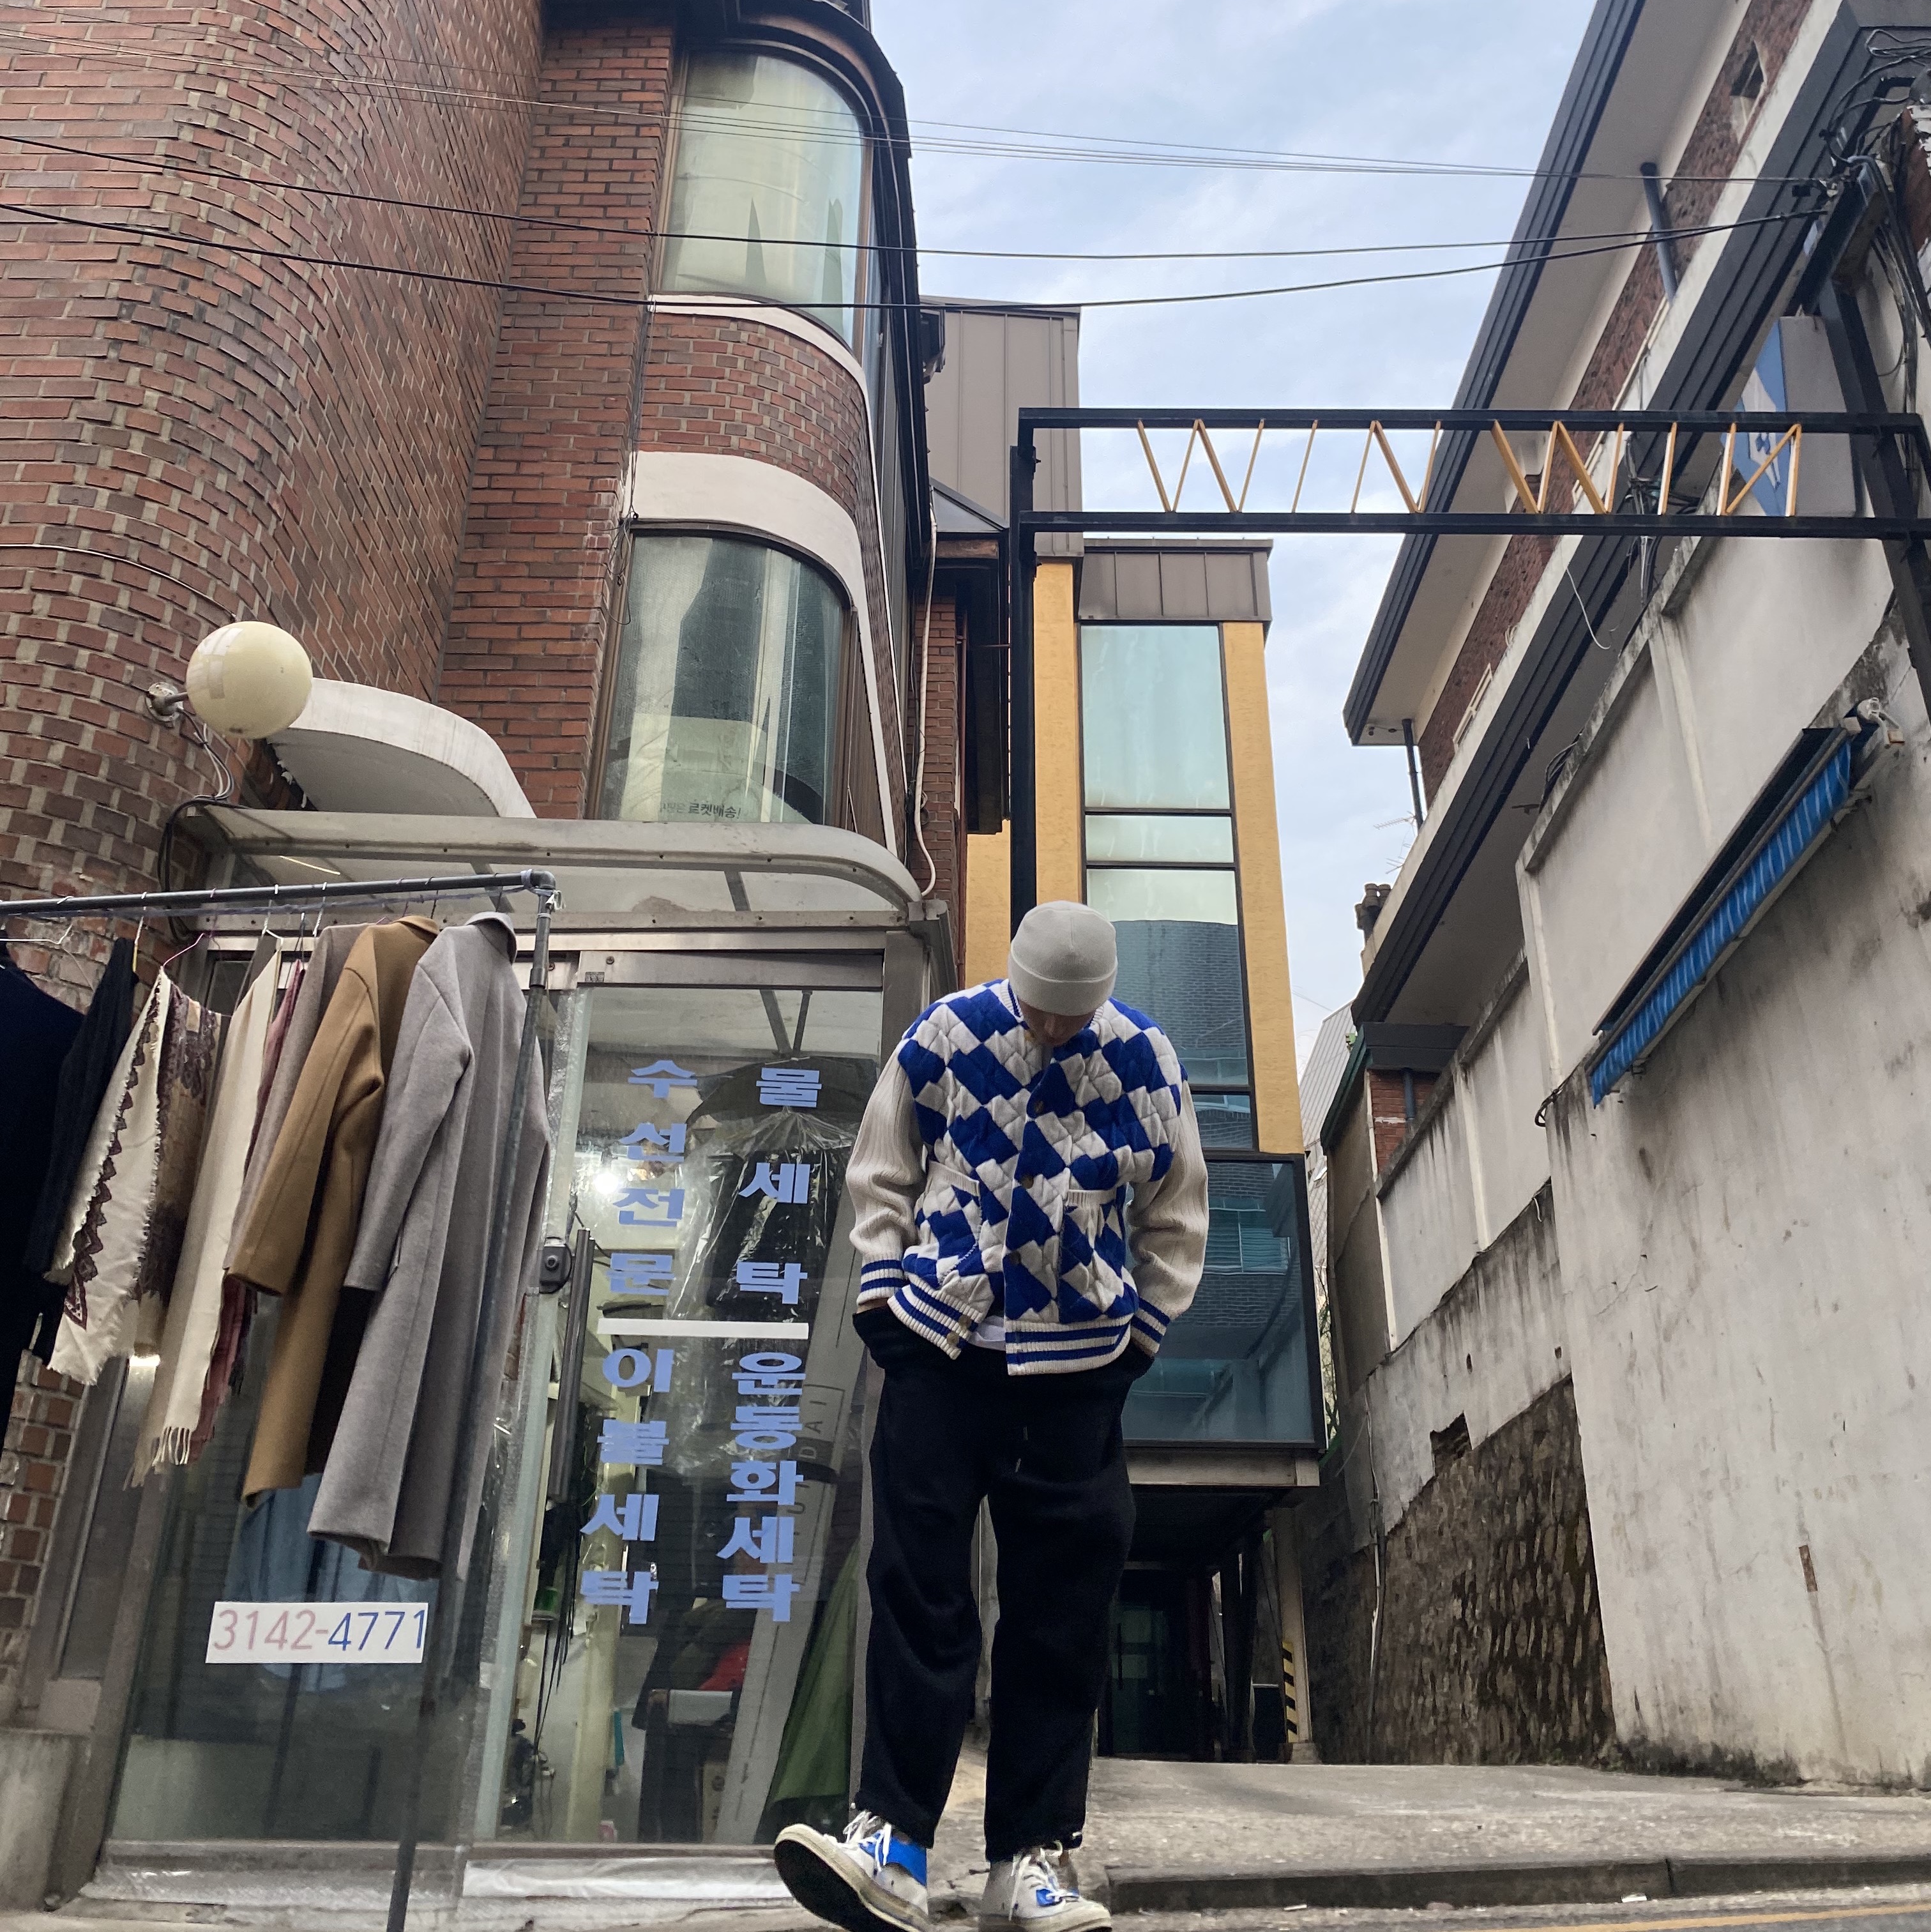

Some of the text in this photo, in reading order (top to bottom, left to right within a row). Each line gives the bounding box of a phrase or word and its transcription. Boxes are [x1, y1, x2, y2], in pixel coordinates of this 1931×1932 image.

[688, 802, 741, 819] 로켓배송!
[606, 1060, 697, 1296] 수선전문
[736, 1067, 822, 1305] 물세탁
[579, 1348, 674, 1625] 이불세탁
[716, 1351, 806, 1622] 운동화세탁
[213, 1609, 425, 1652] 3142-4771
